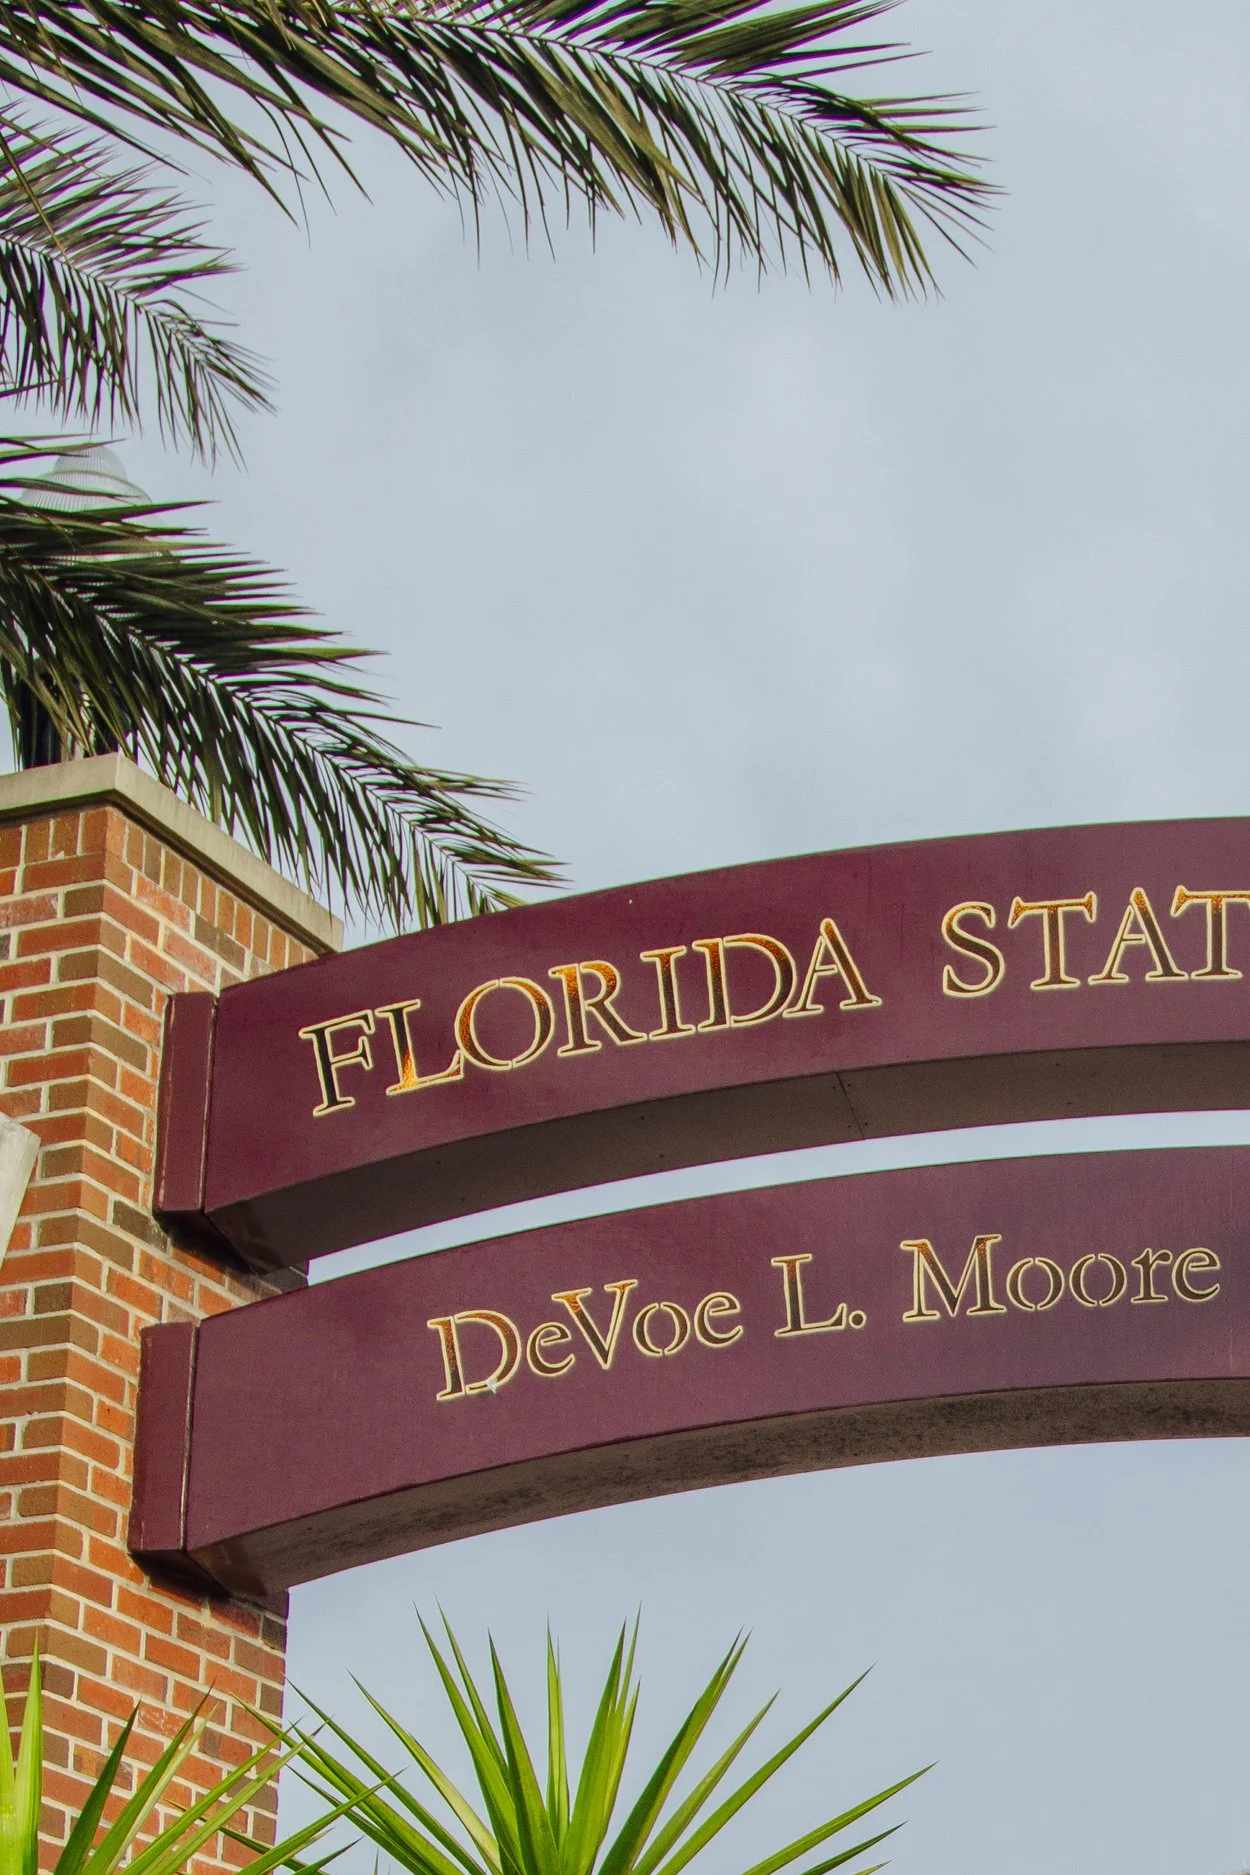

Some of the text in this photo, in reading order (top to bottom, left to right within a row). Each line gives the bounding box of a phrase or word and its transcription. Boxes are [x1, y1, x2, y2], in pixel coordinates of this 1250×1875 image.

[299, 919, 882, 1116] FLORIDA
[427, 1279, 744, 1401] DeVoe
[771, 1253, 867, 1337] L.
[900, 1233, 1221, 1321] Moore
